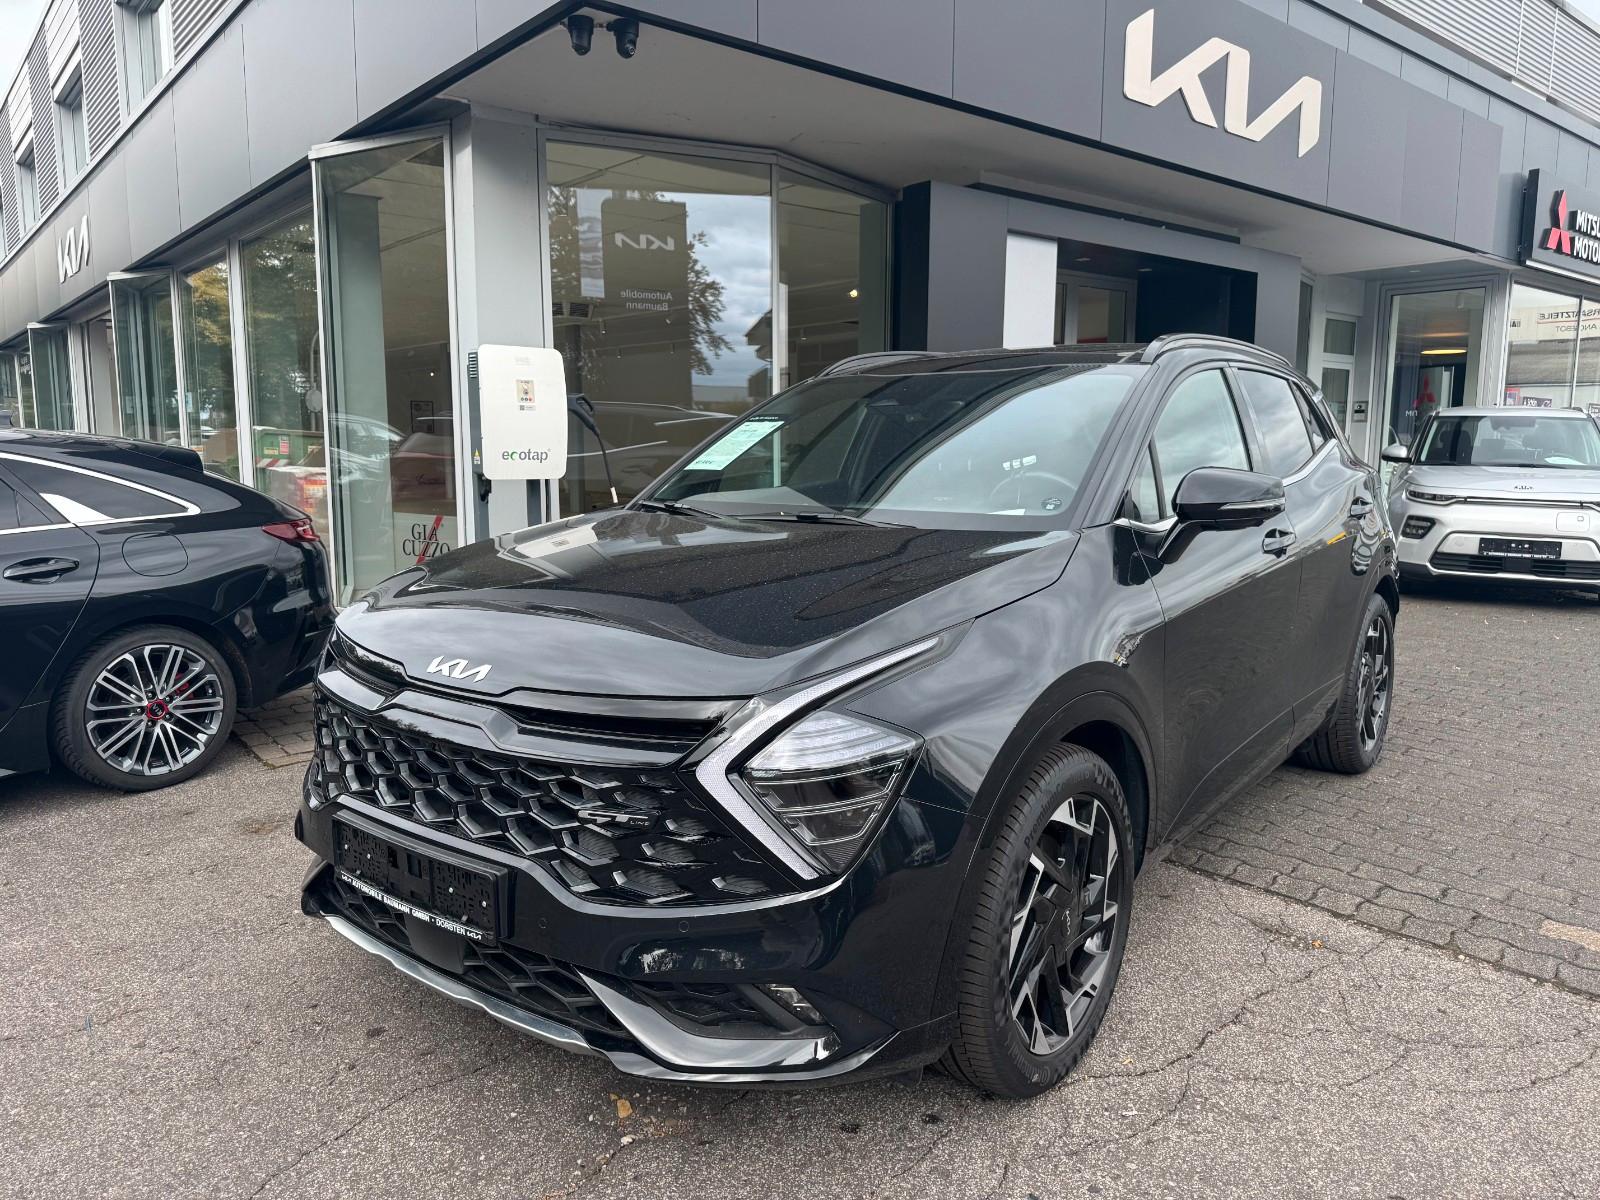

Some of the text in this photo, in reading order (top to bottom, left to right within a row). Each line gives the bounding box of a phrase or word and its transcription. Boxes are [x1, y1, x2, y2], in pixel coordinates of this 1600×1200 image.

[1123, 8, 1322, 158] KIA
[58, 215, 89, 284] KIA
[402, 538, 450, 558] CUZZO
[411, 523, 438, 542] GIA
[426, 655, 492, 683] KIA
[352, 879, 382, 901] AUTOMOBILE
[383, 895, 410, 914] BAUMANN
[436, 918, 466, 936] DORSTEN
